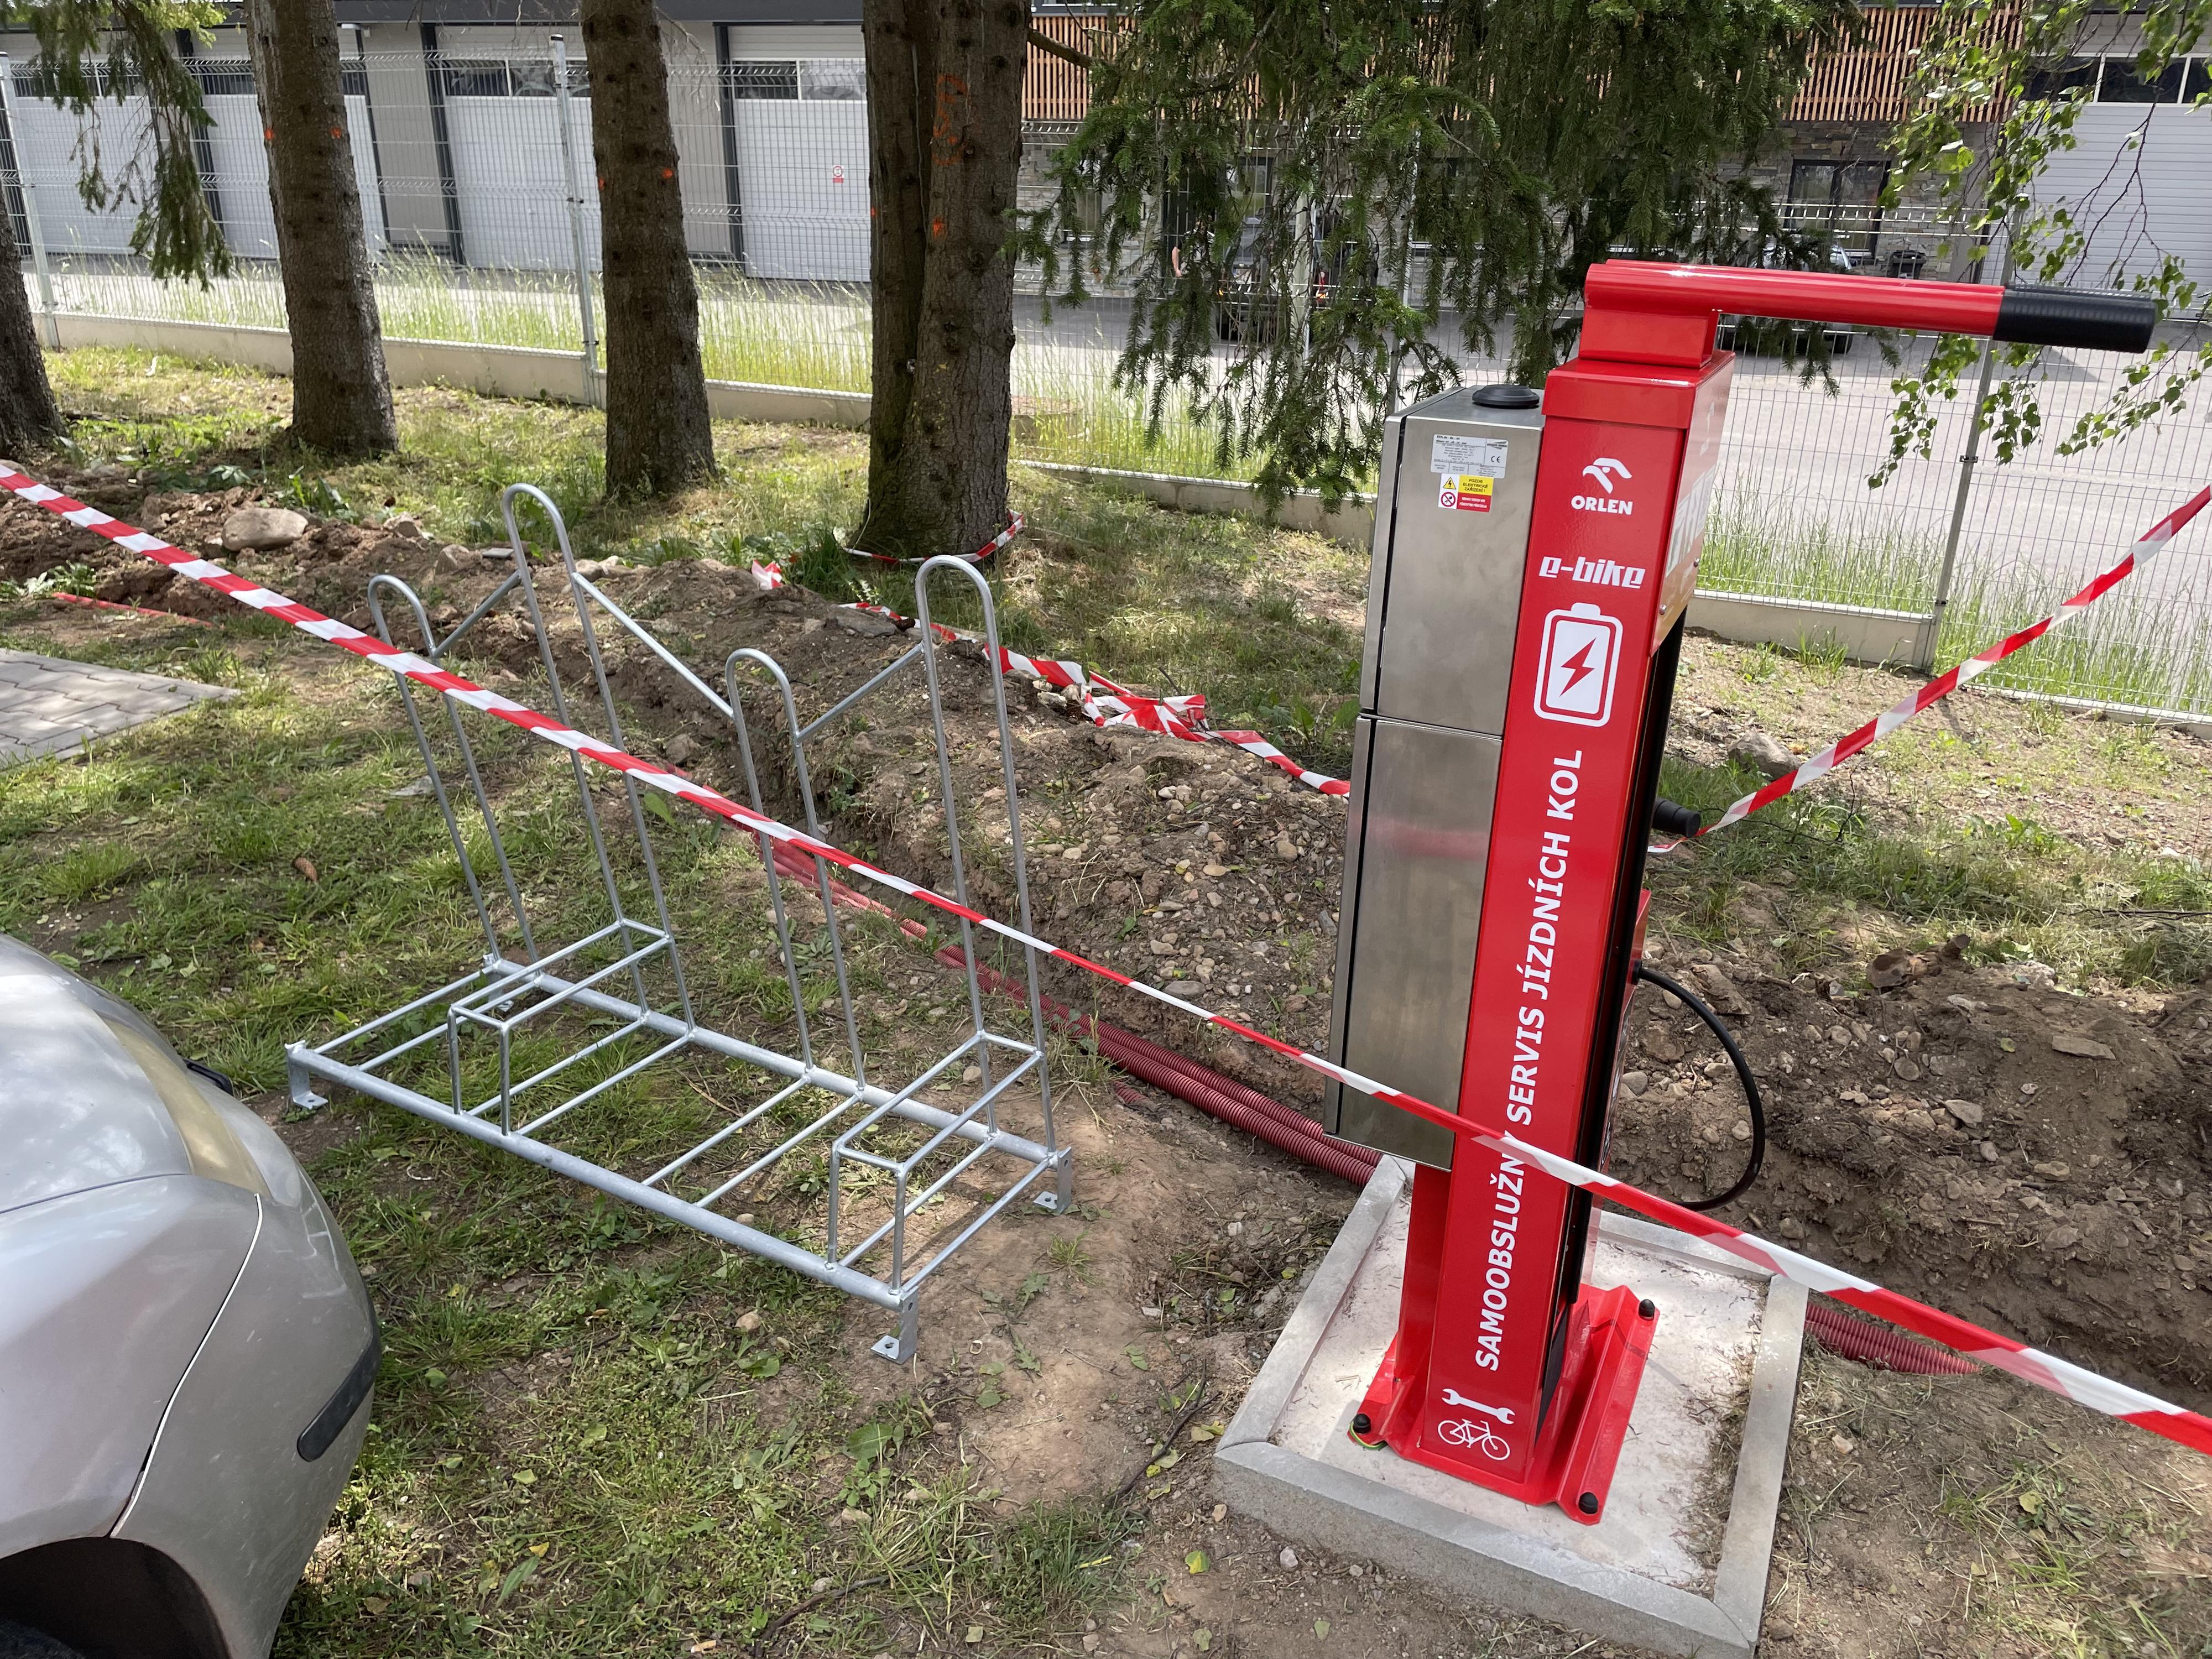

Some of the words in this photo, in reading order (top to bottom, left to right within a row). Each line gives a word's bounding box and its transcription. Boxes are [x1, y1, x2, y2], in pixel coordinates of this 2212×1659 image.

[1571, 495, 1633, 515] ORLEN
[1538, 556, 1646, 589] e-bike
[1546, 750, 1582, 821] KOL
[1511, 831, 1571, 1000] JÍZDNÍCH
[1506, 1006, 1545, 1126] SERVIS
[1475, 1130, 1526, 1371] SAMOOBSLUŽN
